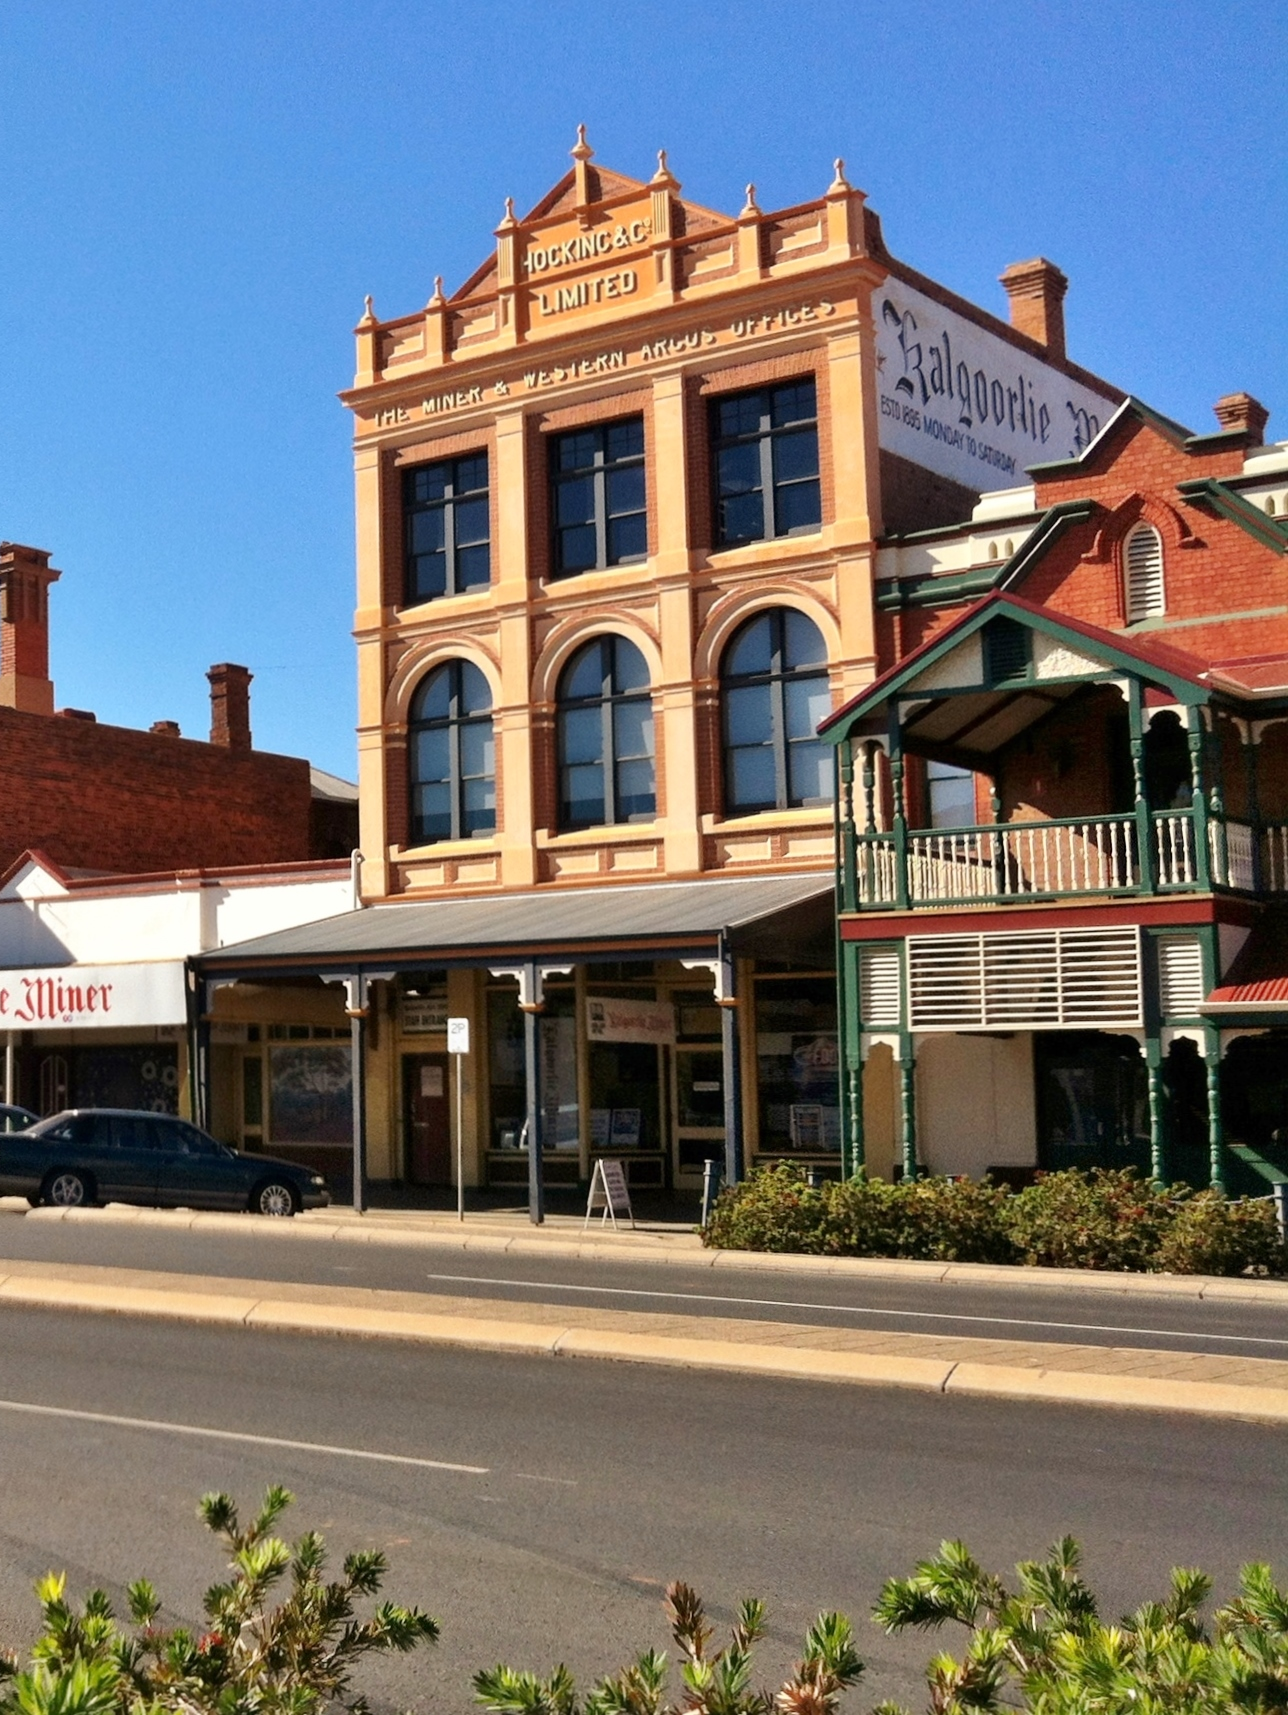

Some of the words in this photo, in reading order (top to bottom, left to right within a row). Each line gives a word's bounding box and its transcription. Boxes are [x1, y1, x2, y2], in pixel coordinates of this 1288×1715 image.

[539, 270, 637, 315] LIMITED
[374, 406, 409, 427] THE
[422, 386, 483, 416] MINER
[493, 380, 509, 397] &
[523, 350, 626, 388] WESTERN
[641, 329, 716, 361] ARGUS
[730, 297, 836, 338] OFFICES
[882, 299, 1050, 445] Kalgoorlie
[923, 415, 965, 451] MONDAY
[966, 434, 977, 457] TO
[978, 441, 1016, 475] SATURDAY
[15, 976, 113, 1022] Miner
[450, 1022, 466, 1035] 2P
